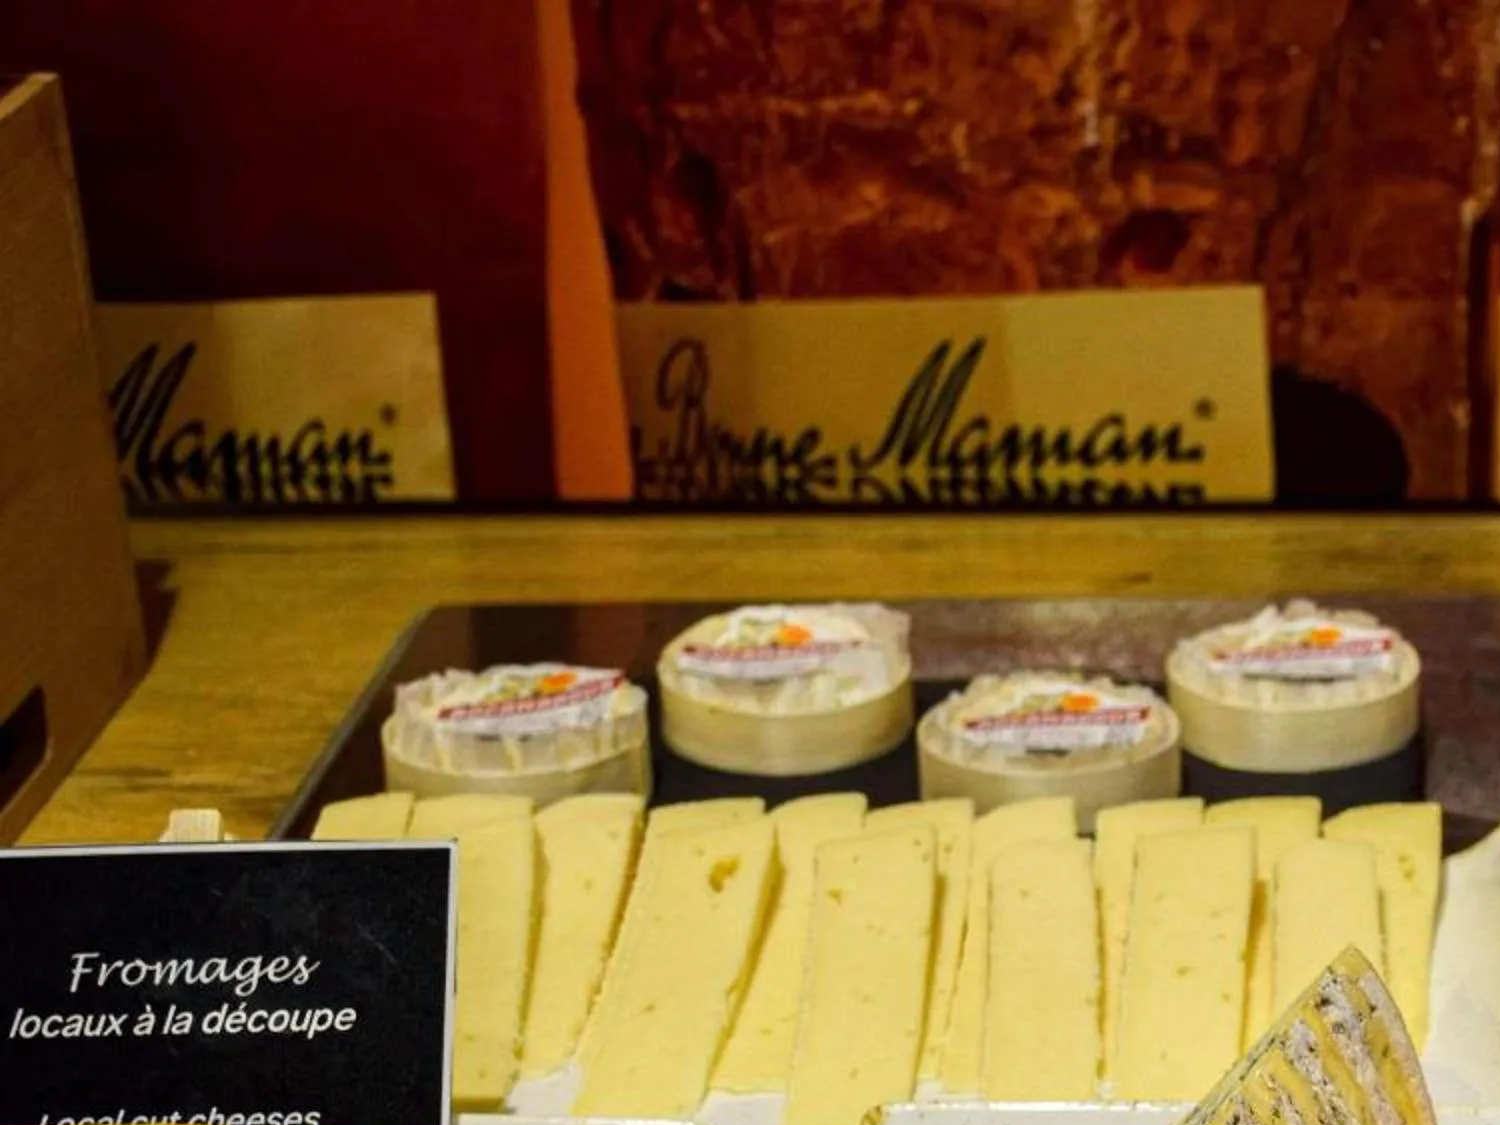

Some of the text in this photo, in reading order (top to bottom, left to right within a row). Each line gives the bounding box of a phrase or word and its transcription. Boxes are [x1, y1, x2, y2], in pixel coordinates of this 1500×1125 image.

[69, 951, 321, 996] Fromages
[9, 1002, 357, 1039] locaux à la découpe
